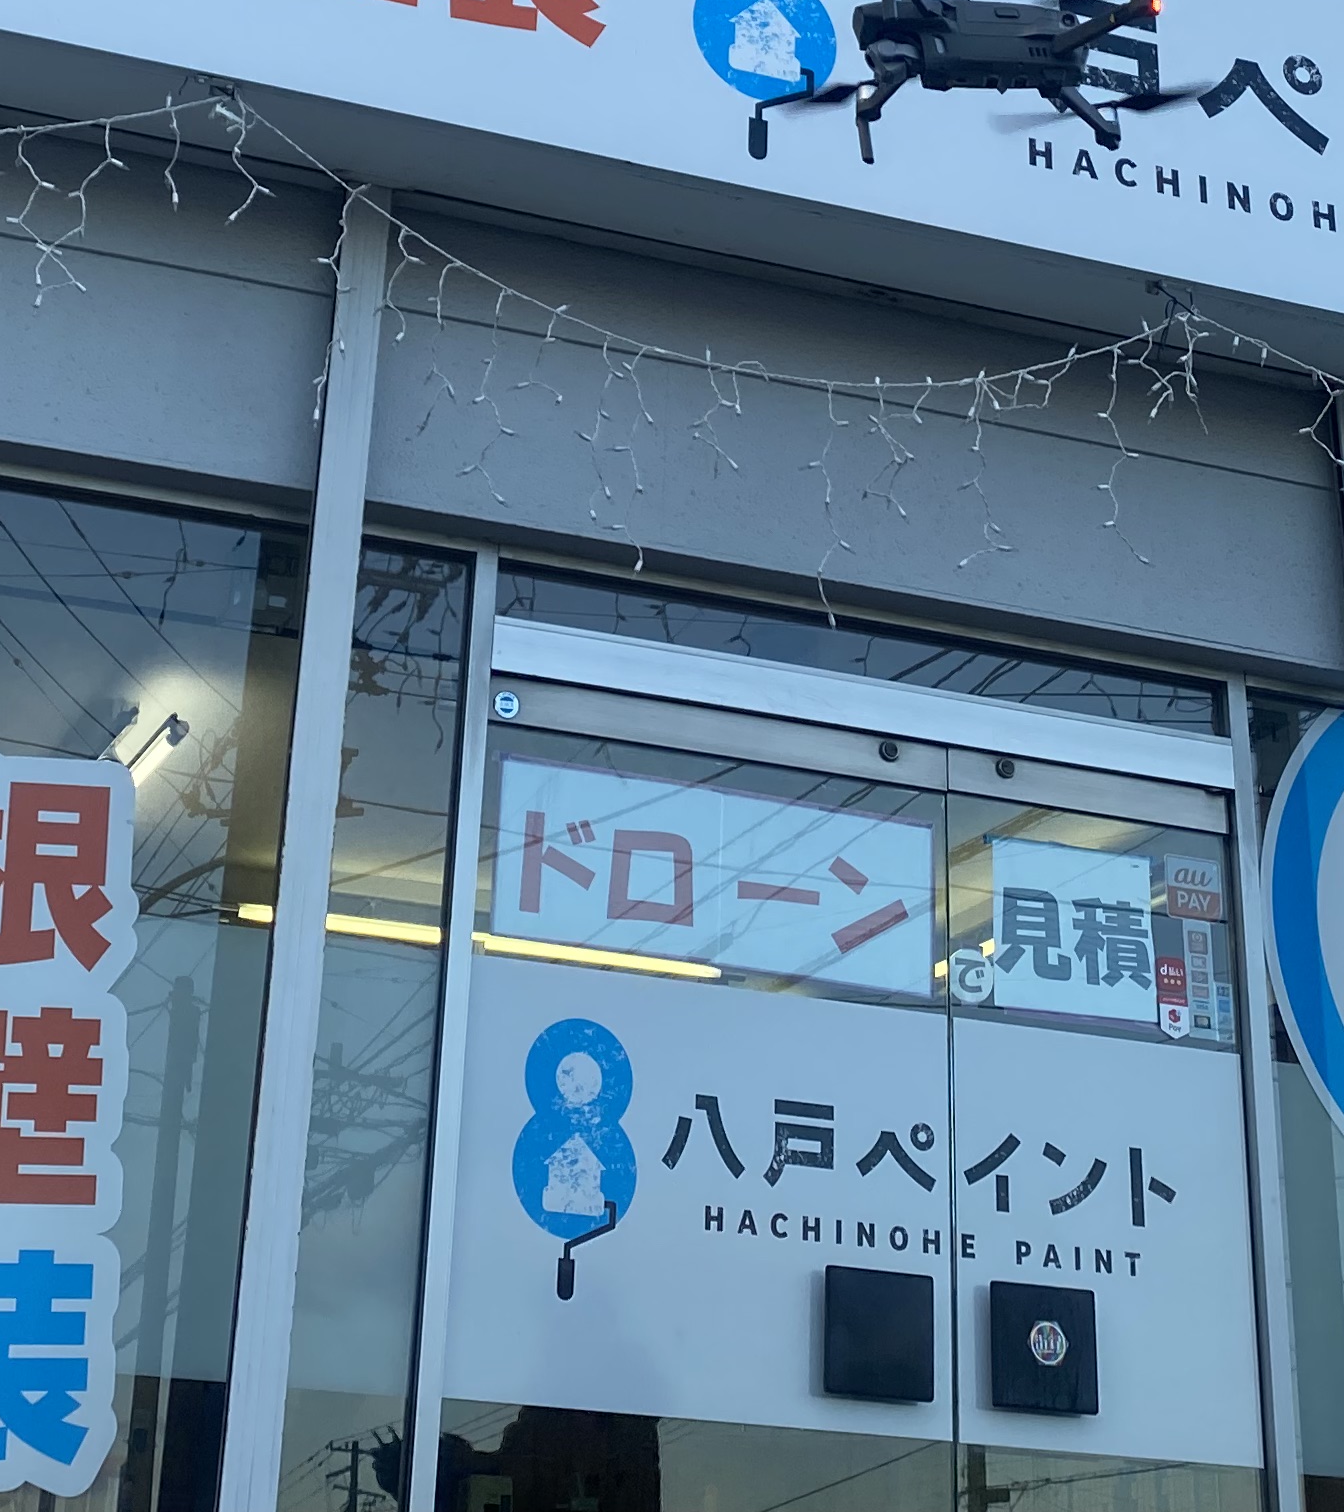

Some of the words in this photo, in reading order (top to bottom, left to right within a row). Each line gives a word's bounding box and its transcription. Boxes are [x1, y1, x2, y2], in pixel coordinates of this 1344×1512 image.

[518, 810, 909, 954] ドローン
[1174, 868, 1212, 887] au
[1176, 890, 1211, 912] PAY
[996, 886, 1153, 990] 見積
[957, 956, 985, 994] で
[661, 1093, 1177, 1228] 八戸ペイント
[704, 1204, 976, 1259] HACHINOHE
[1015, 1240, 1142, 1277] PAINT
